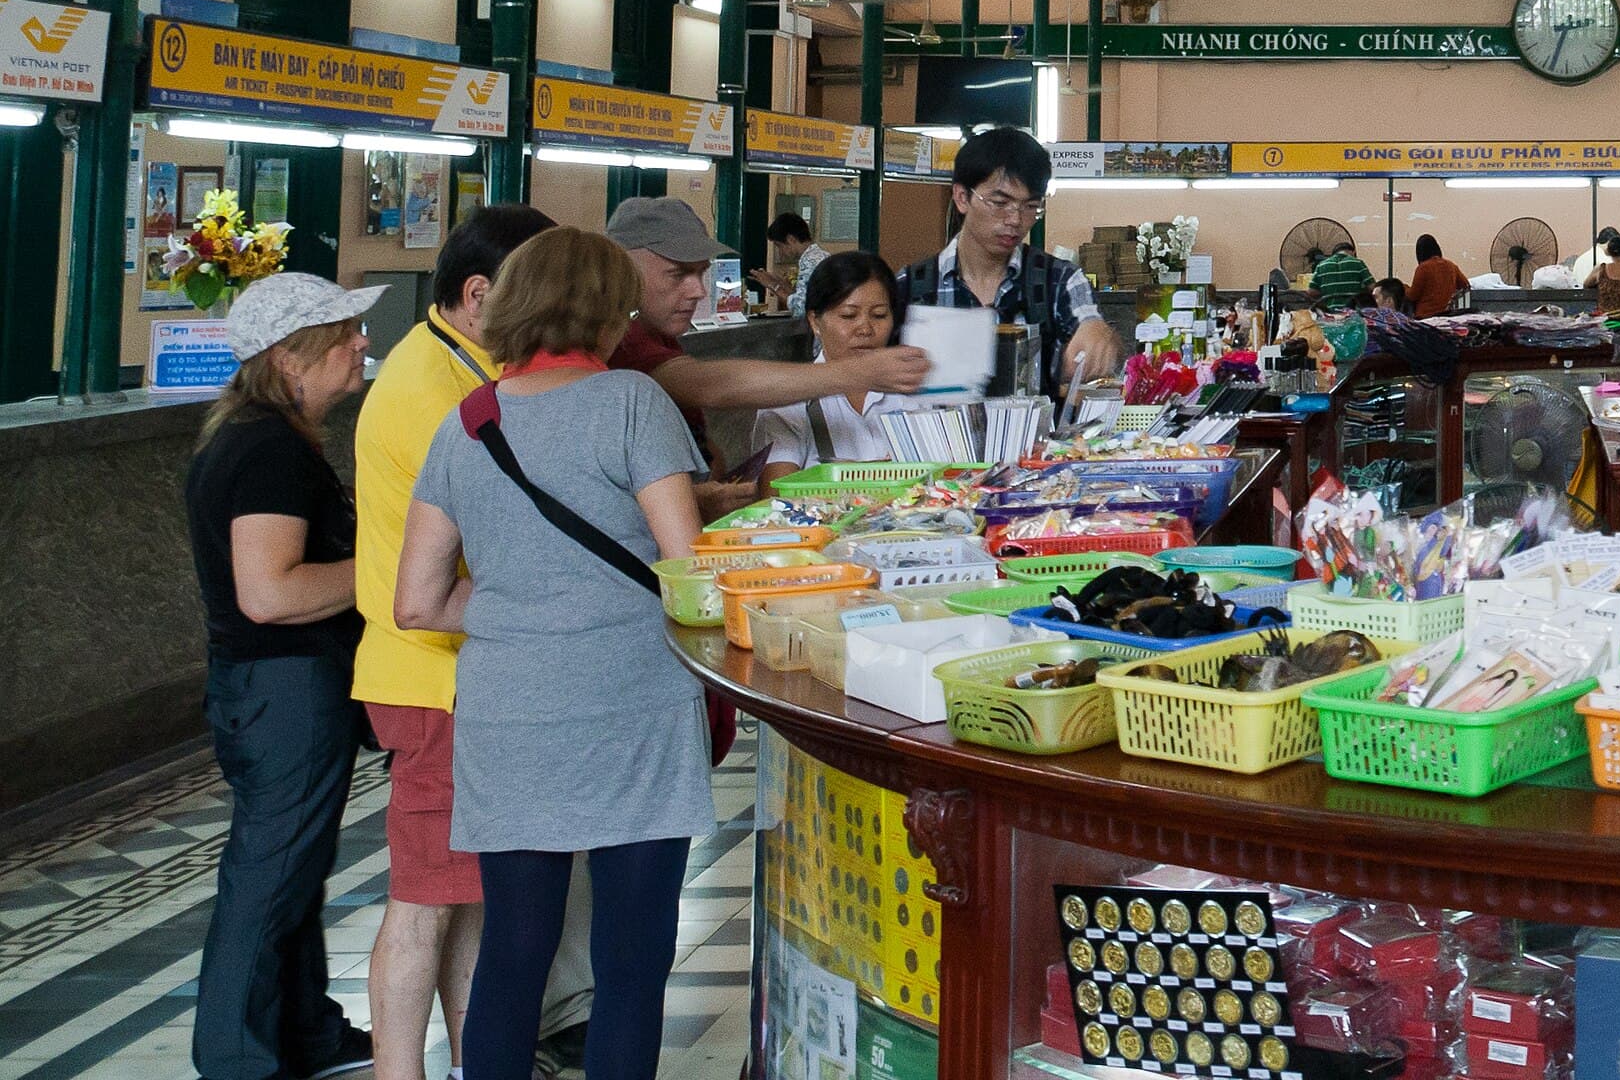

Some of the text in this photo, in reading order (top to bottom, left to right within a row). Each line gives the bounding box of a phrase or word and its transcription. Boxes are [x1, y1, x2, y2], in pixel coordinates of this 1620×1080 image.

[166, 36, 180, 62] 12
[1162, 28, 1492, 50] NHANH CHÓNG CHÍNH XÁC
[10, 56, 91, 73] VIETNAM POST
[214, 39, 238, 67] BÁN
[242, 42, 257, 70] VÉ
[261, 47, 284, 74] MÁY
[288, 55, 309, 77] BAY
[361, 62, 375, 90] HỘ
[224, 76, 393, 109] AIR TICKET PASSPORT DOCUMENTARY SERVICE
[541, 91, 549, 112] 11
[461, 107, 502, 119] VIETNAM POST
[1052, 151, 1094, 159] EXPRESS
[1270, 150, 1277, 163] 7
[1343, 145, 1400, 160] ĐÓNG
[1408, 145, 1443, 160] GÓI
[1451, 146, 1492, 159] BƯU
[1501, 141, 1561, 159] PHẨM
[1056, 161, 1088, 169] AGENCY
[1585, 608, 1616, 618] GNET
[871, 1045, 885, 1069] 50
